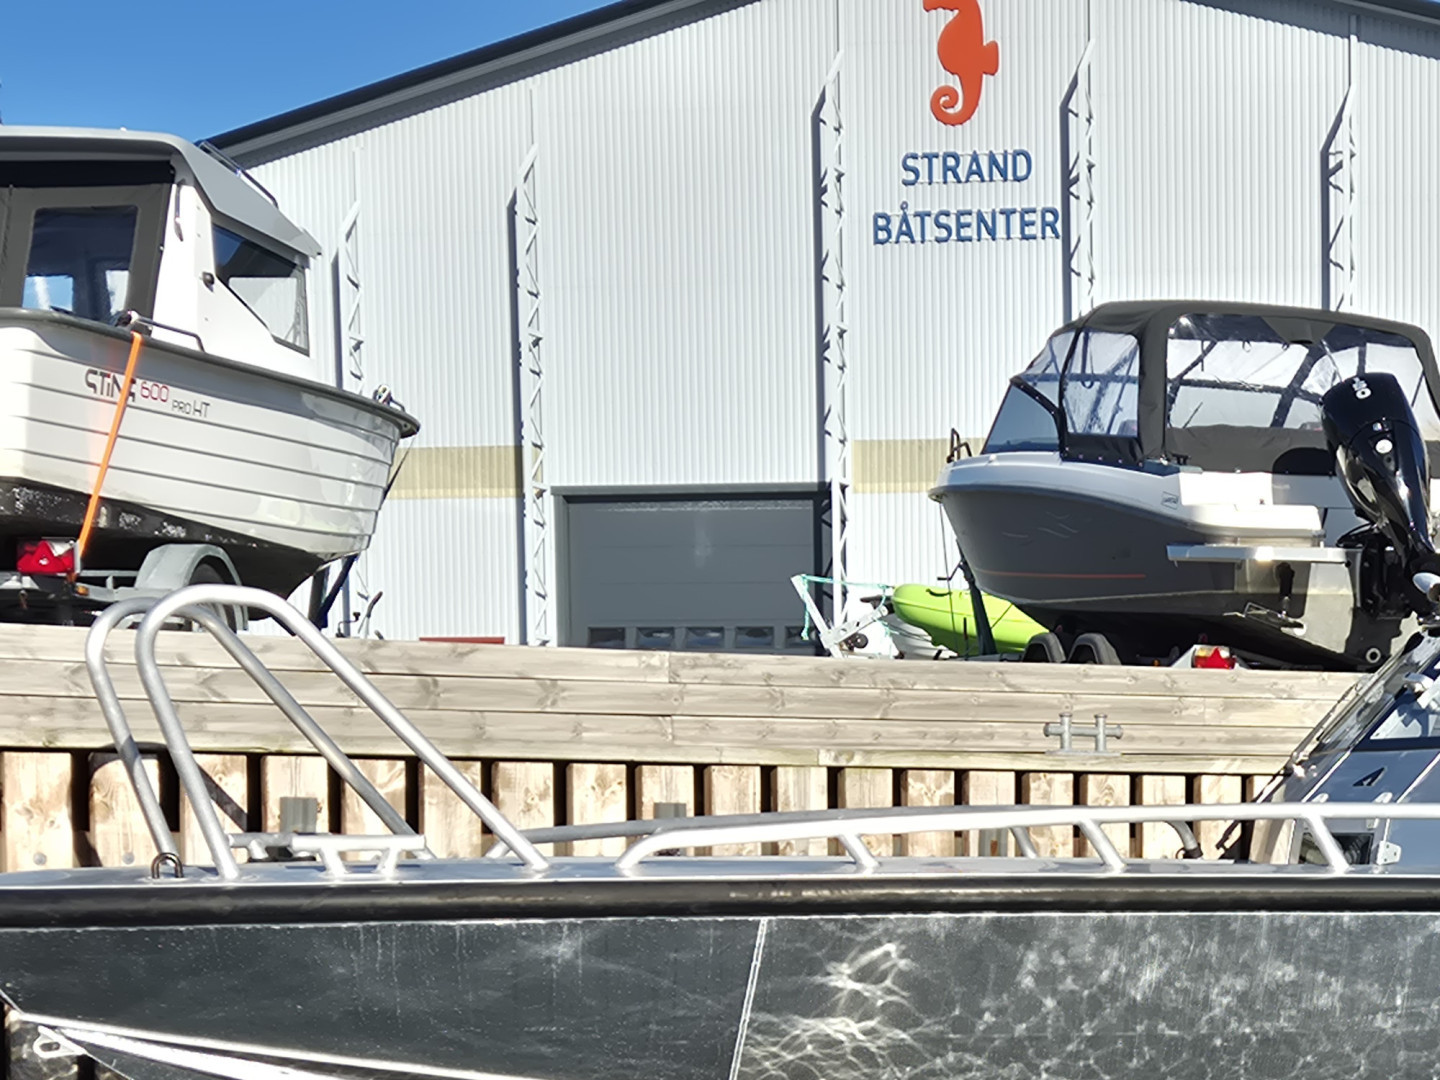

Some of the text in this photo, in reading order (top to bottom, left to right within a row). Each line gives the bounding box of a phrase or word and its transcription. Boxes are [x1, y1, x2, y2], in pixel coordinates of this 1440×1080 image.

[901, 149, 1033, 186] STRAND
[873, 201, 1061, 245] BÅTSENTER
[140, 380, 170, 403] 600
[171, 399, 192, 415] PRO
[192, 400, 211, 418] HT
